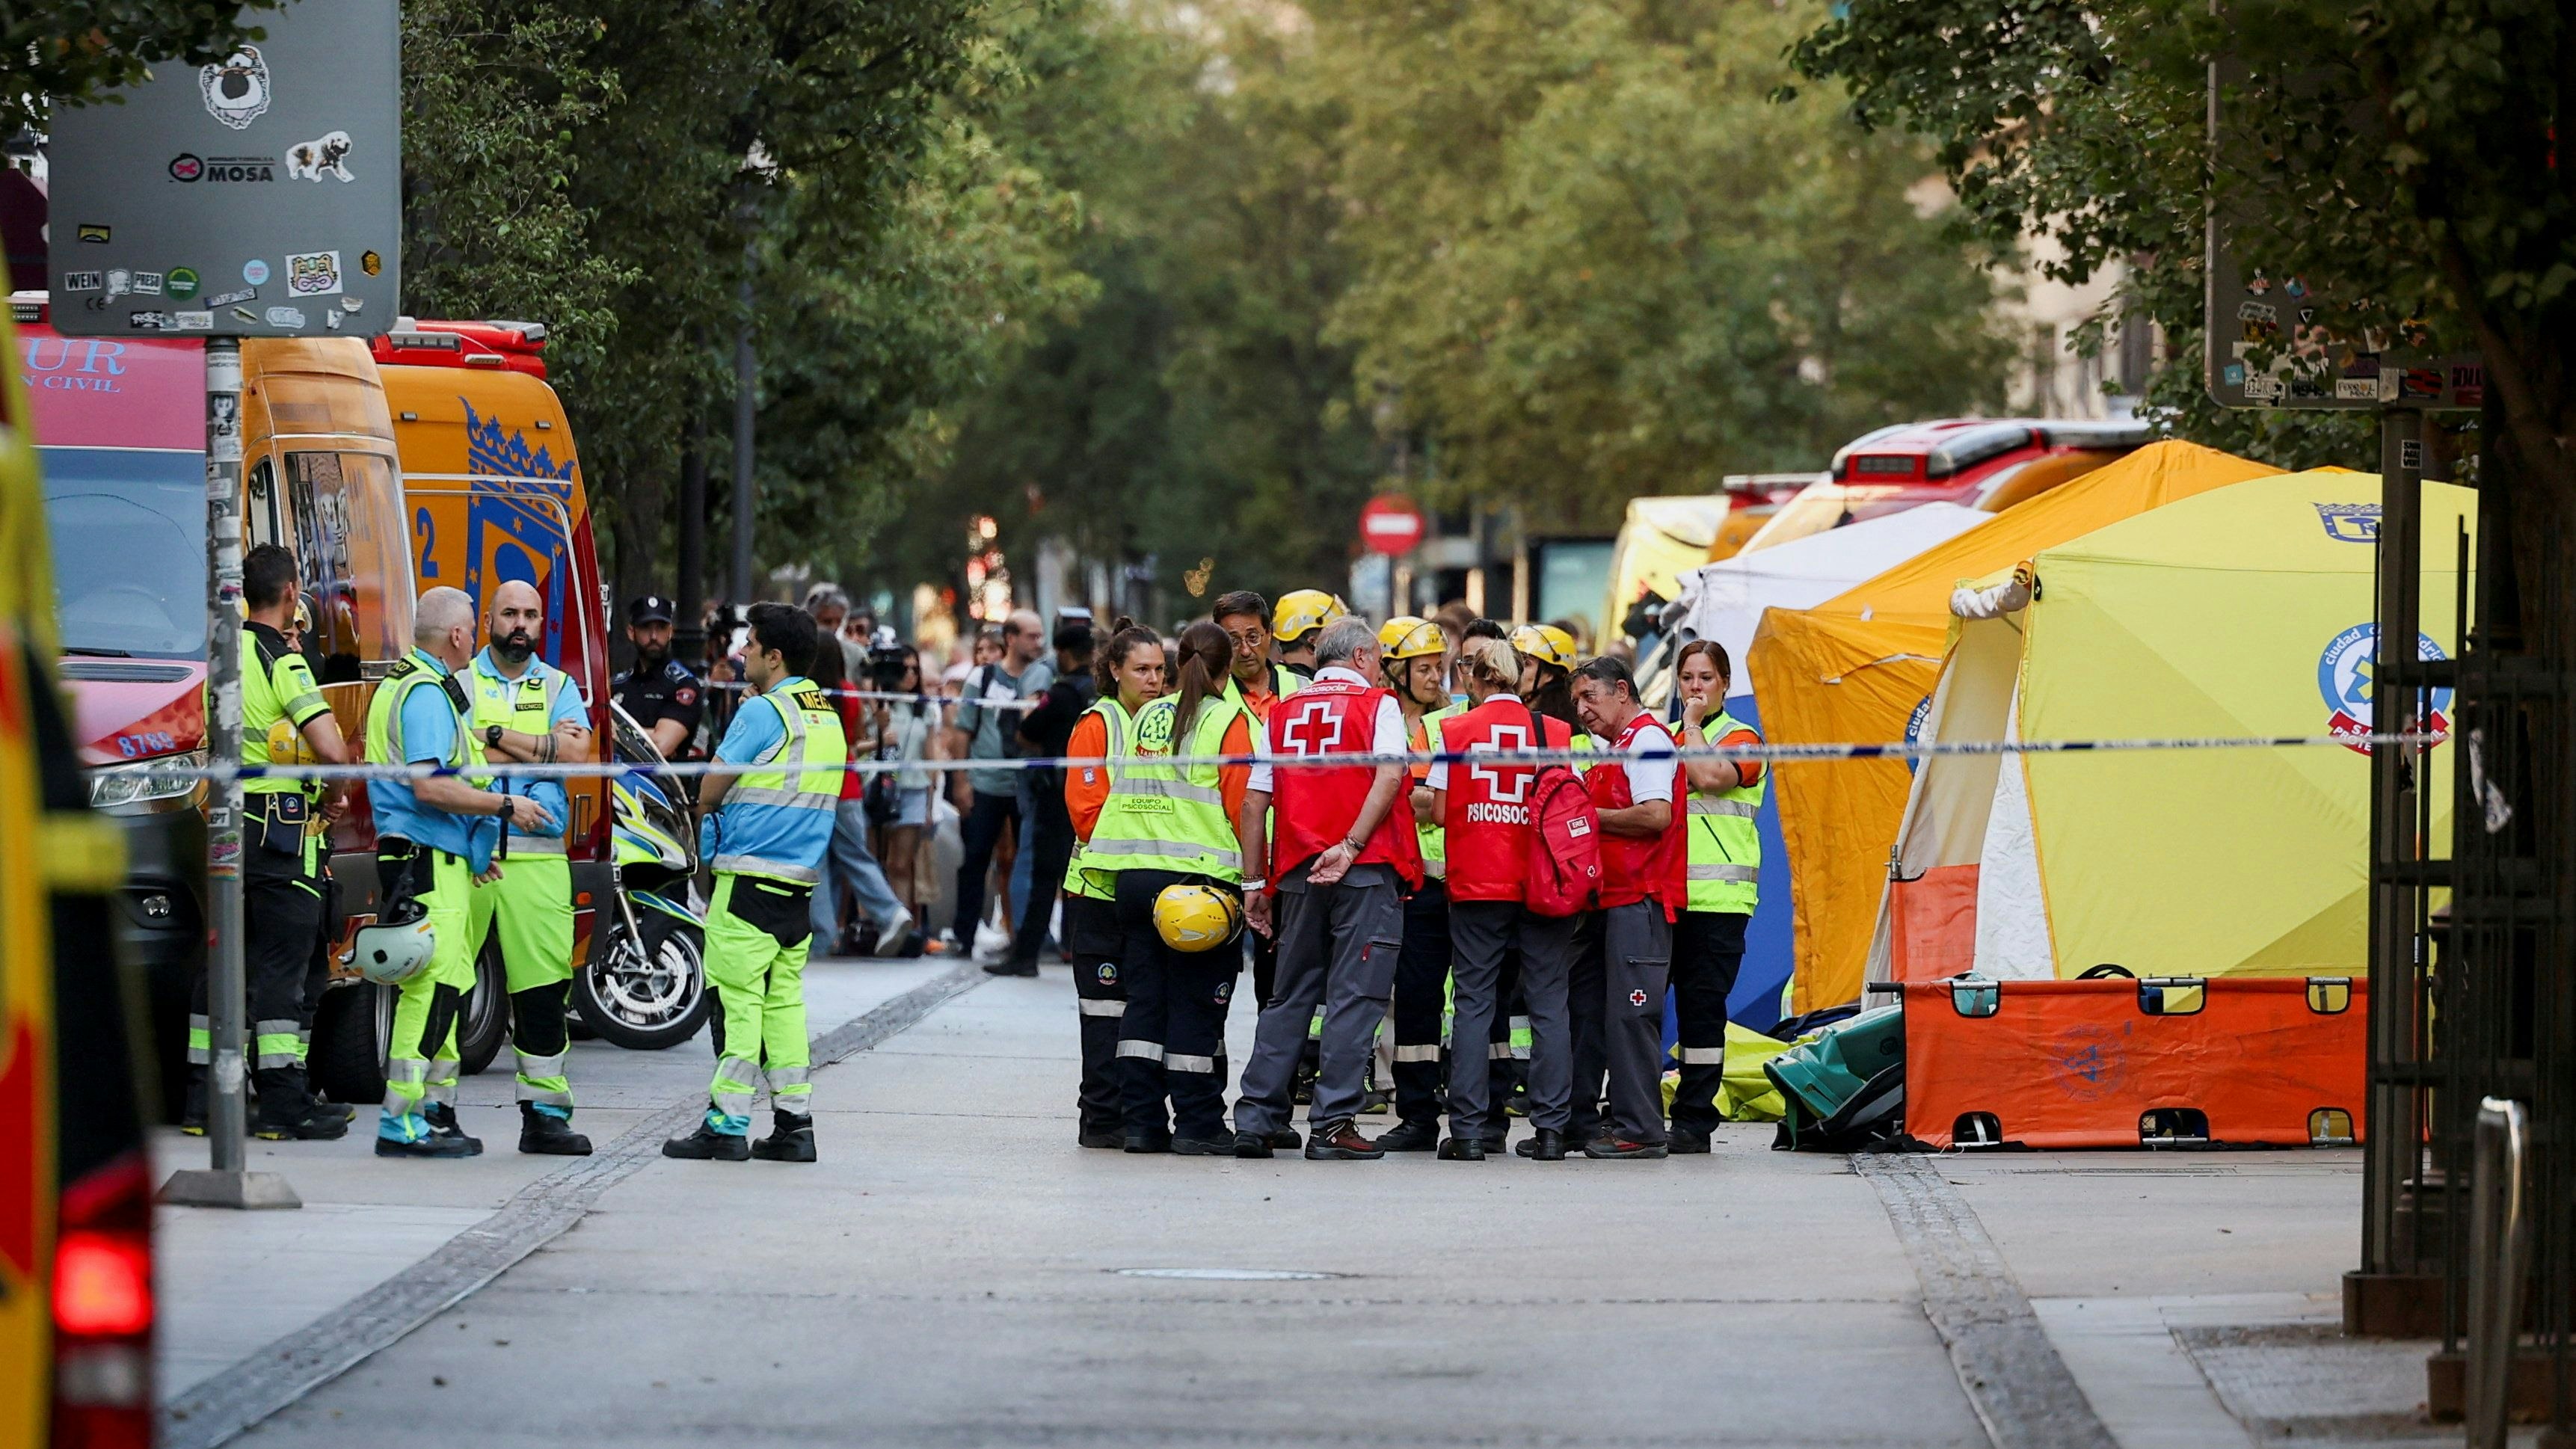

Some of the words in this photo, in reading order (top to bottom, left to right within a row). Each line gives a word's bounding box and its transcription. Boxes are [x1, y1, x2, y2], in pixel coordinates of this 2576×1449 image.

[208, 166, 274, 182] MOSA
[67, 271, 100, 289] WEIN
[43, 375, 120, 393] CIVIL
[2325, 627, 2362, 665] ciudad
[1909, 698, 1931, 736] ciuda
[1467, 802, 1531, 825] PSICOSOC
